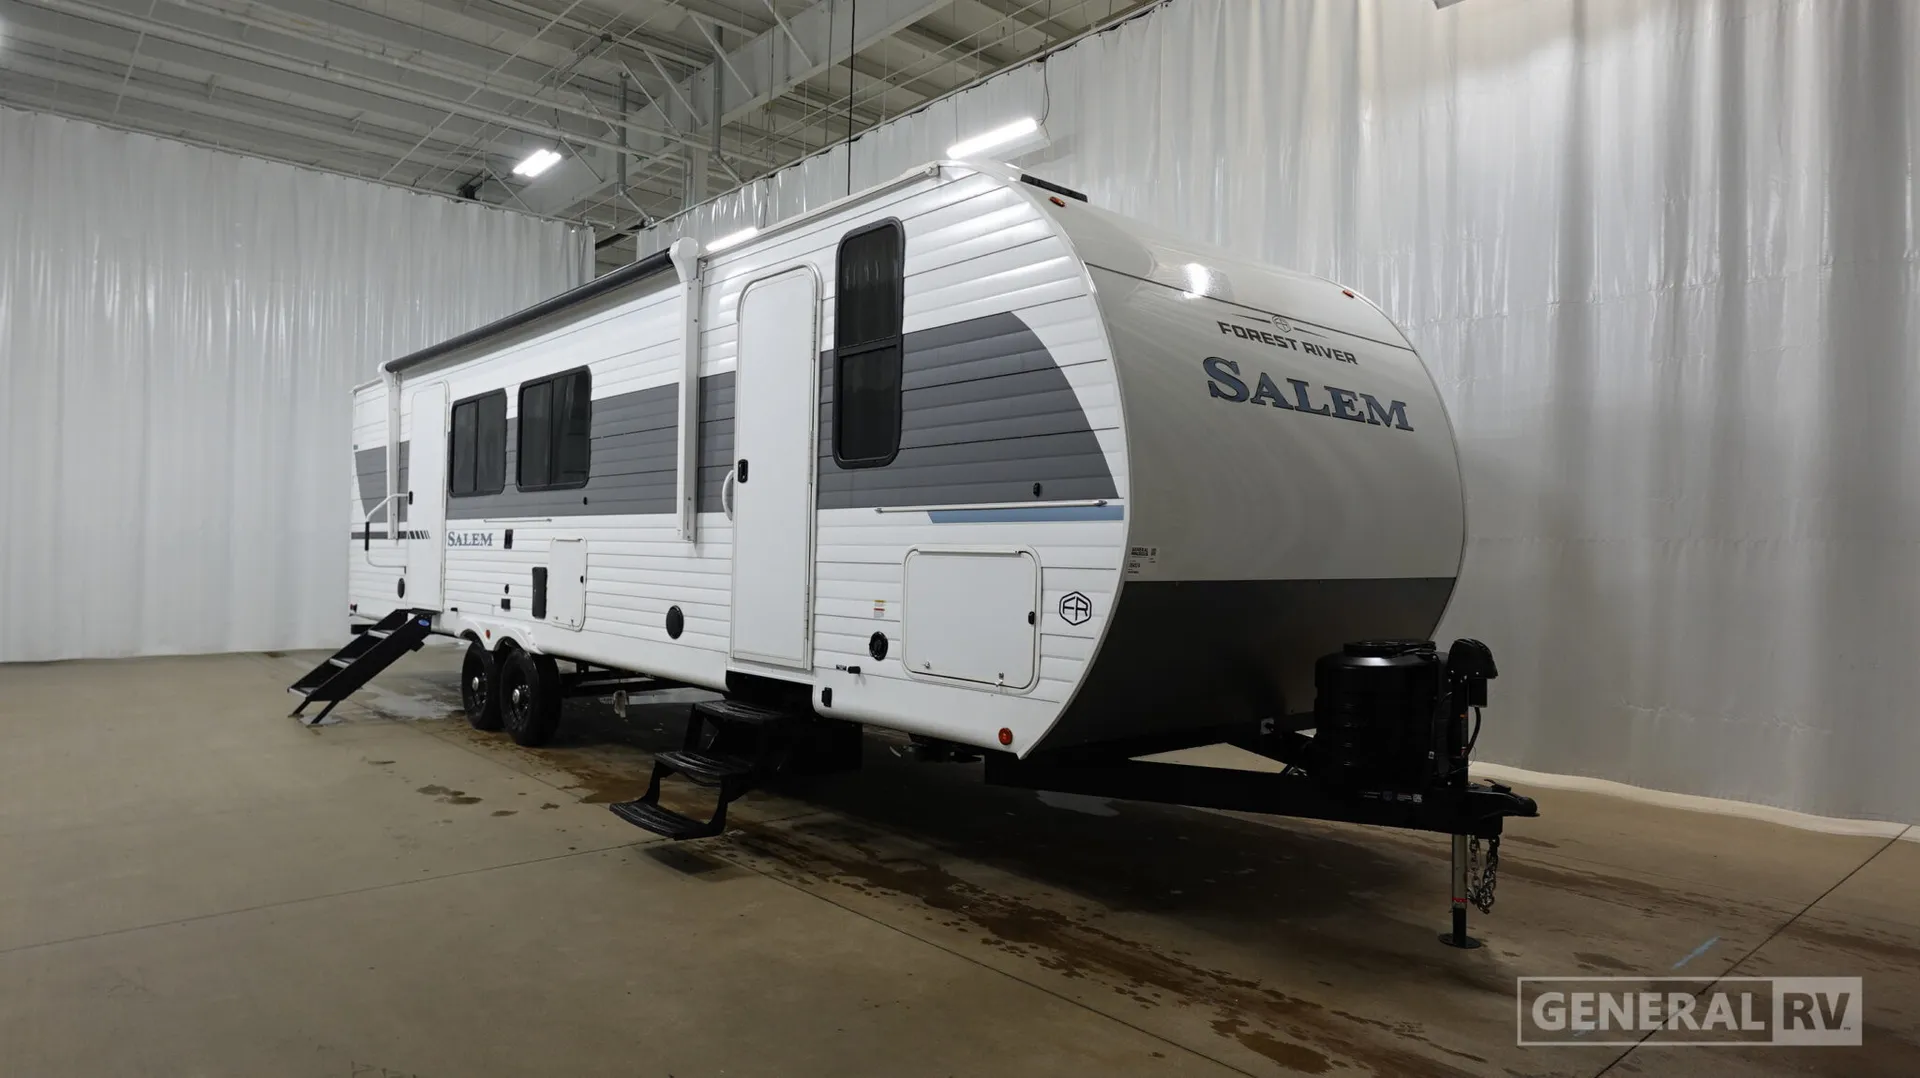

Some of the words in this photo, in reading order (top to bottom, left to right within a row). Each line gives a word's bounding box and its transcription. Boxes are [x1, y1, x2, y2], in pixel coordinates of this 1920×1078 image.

[1217, 320, 1298, 351] FOREST
[1300, 340, 1359, 365] RIVER
[1202, 356, 1415, 432] SALEM
[447, 531, 494, 547] SALEM
